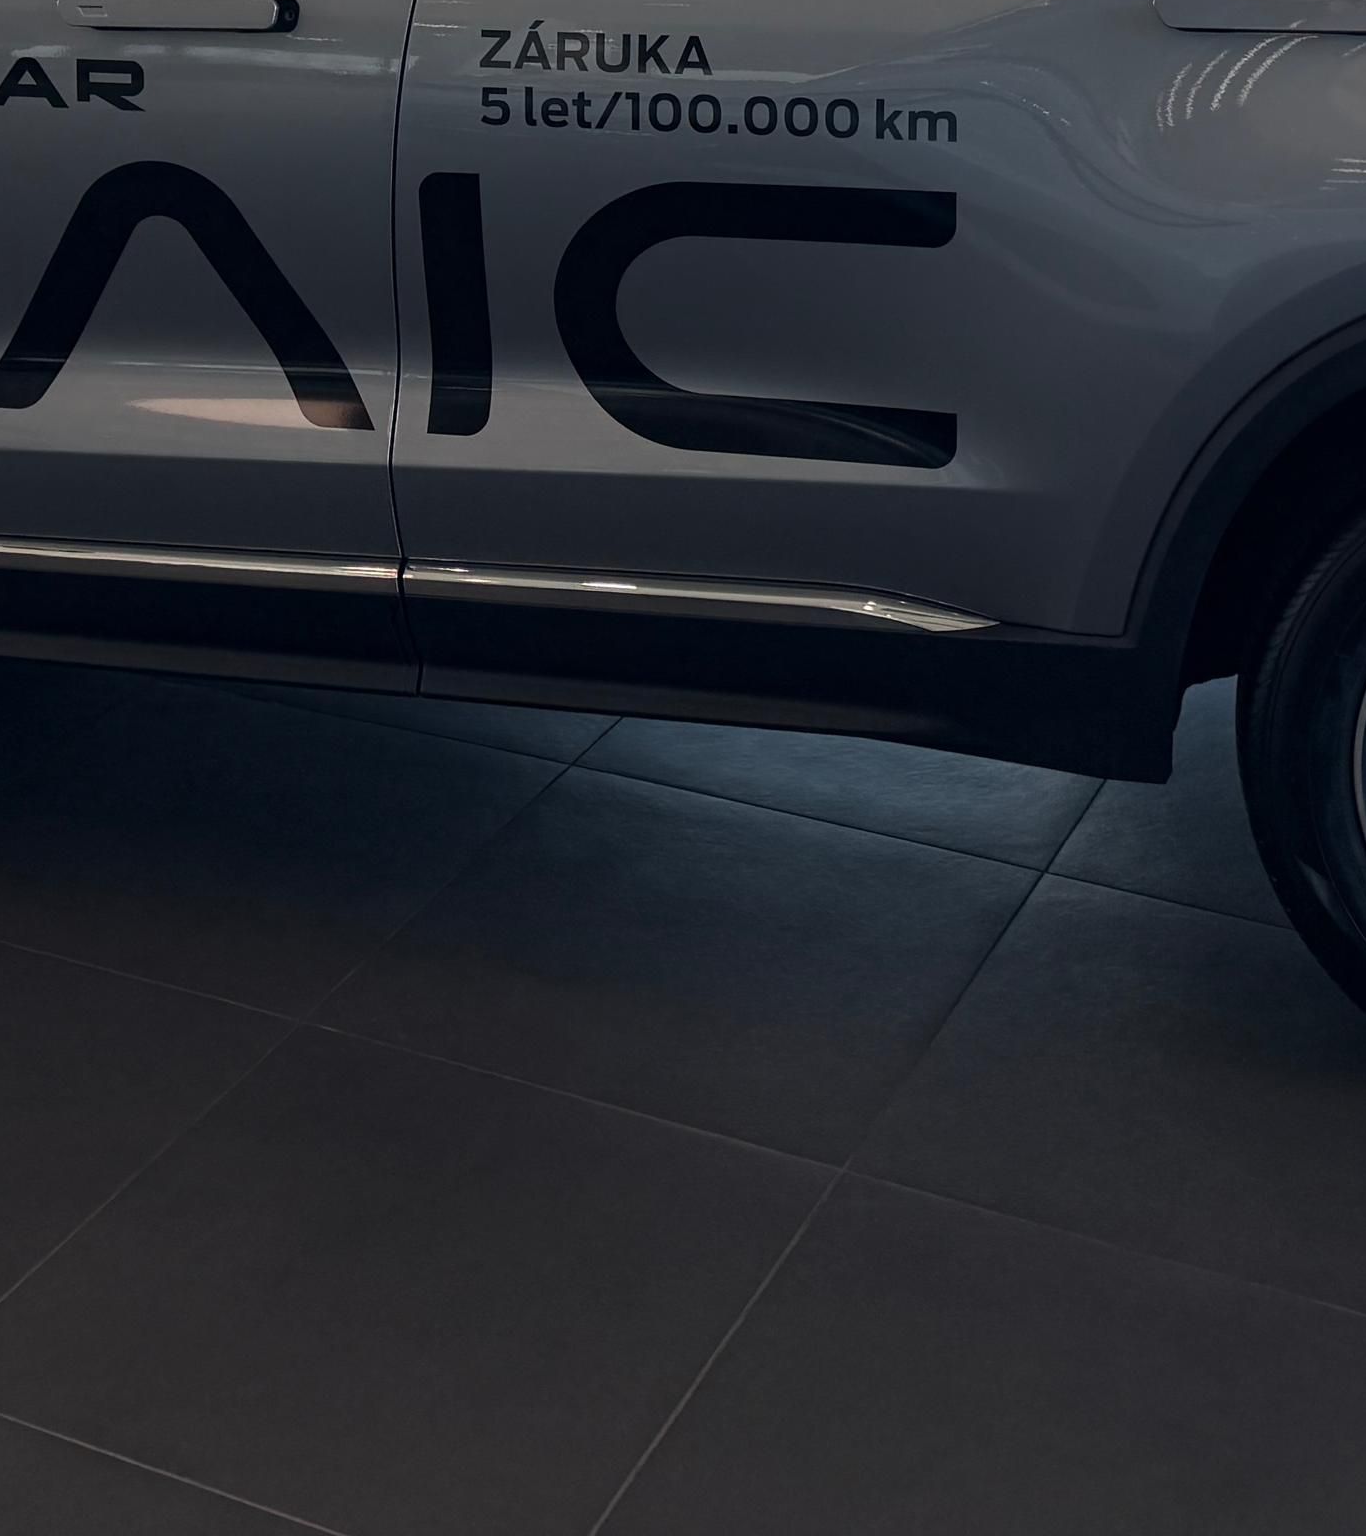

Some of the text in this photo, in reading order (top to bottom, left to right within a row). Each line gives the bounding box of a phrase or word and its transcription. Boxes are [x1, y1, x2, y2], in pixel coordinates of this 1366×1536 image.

[479, 20, 713, 76] ZÁRUKA
[481, 87, 958, 143] 5 let/100.000 km
